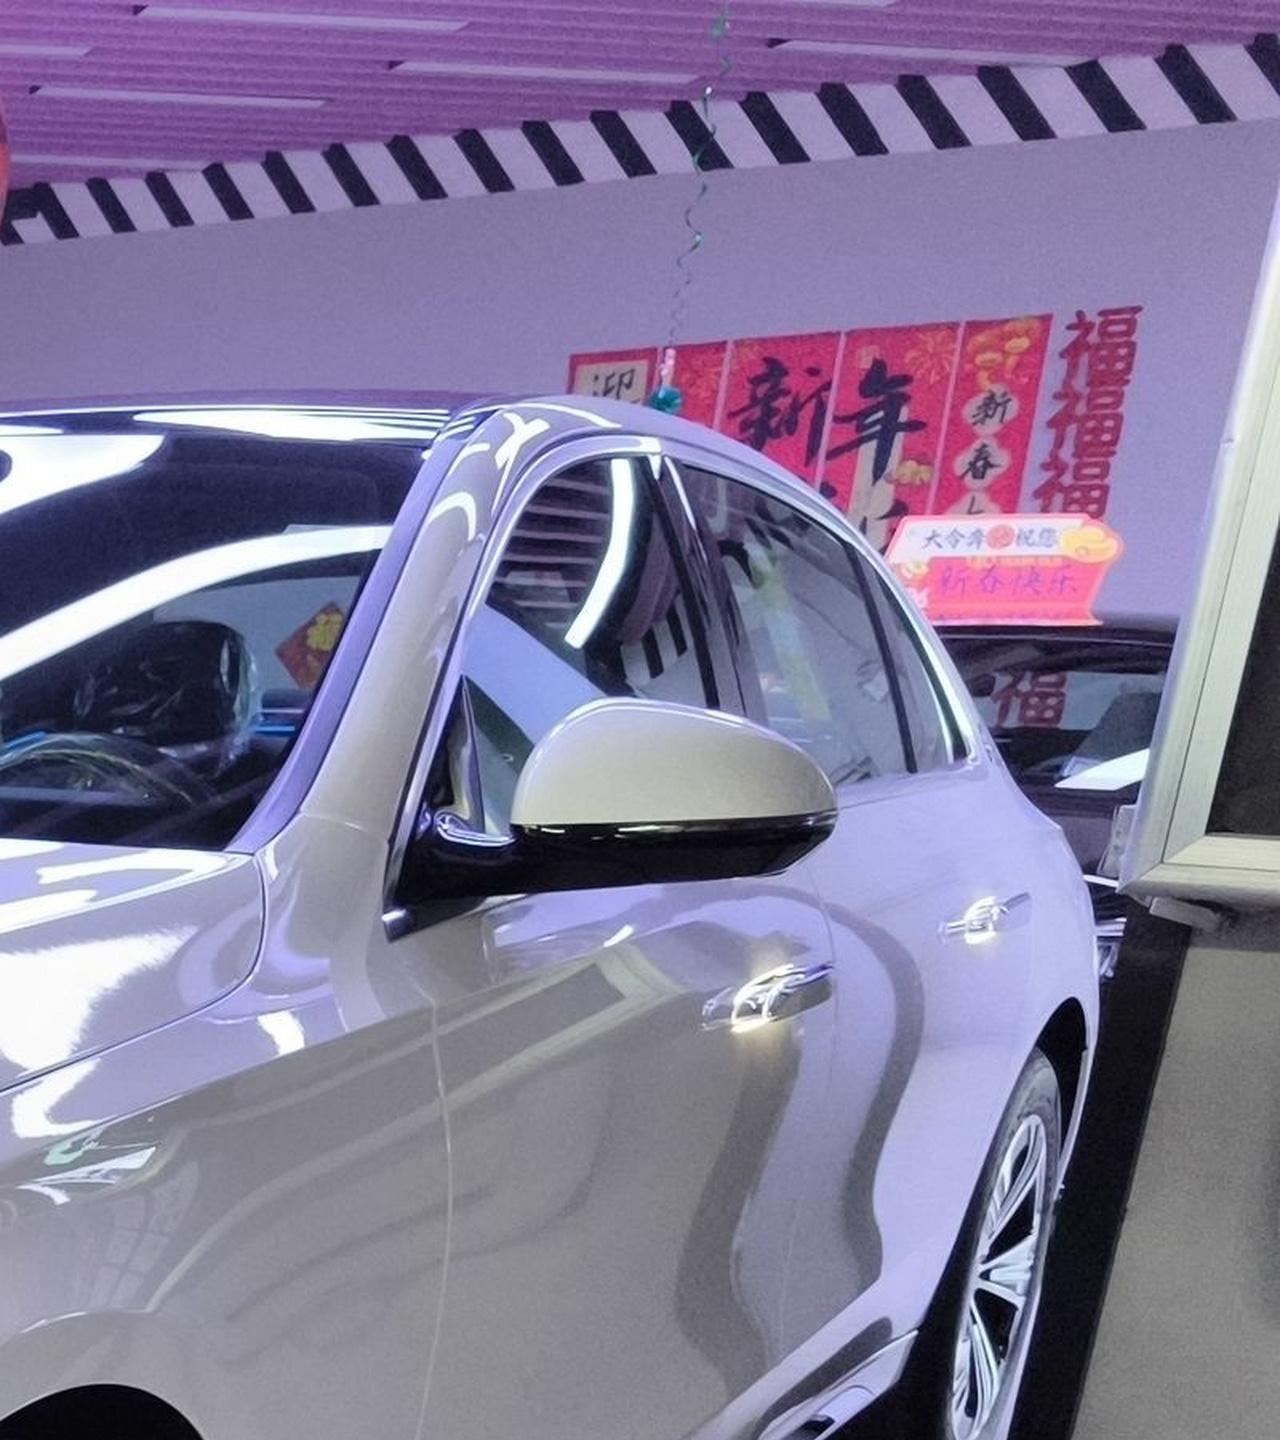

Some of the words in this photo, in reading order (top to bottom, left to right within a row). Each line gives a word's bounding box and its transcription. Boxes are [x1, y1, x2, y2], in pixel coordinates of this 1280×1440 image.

[728, 356, 928, 485] 新年
[939, 564, 1078, 598] 新春快乐
